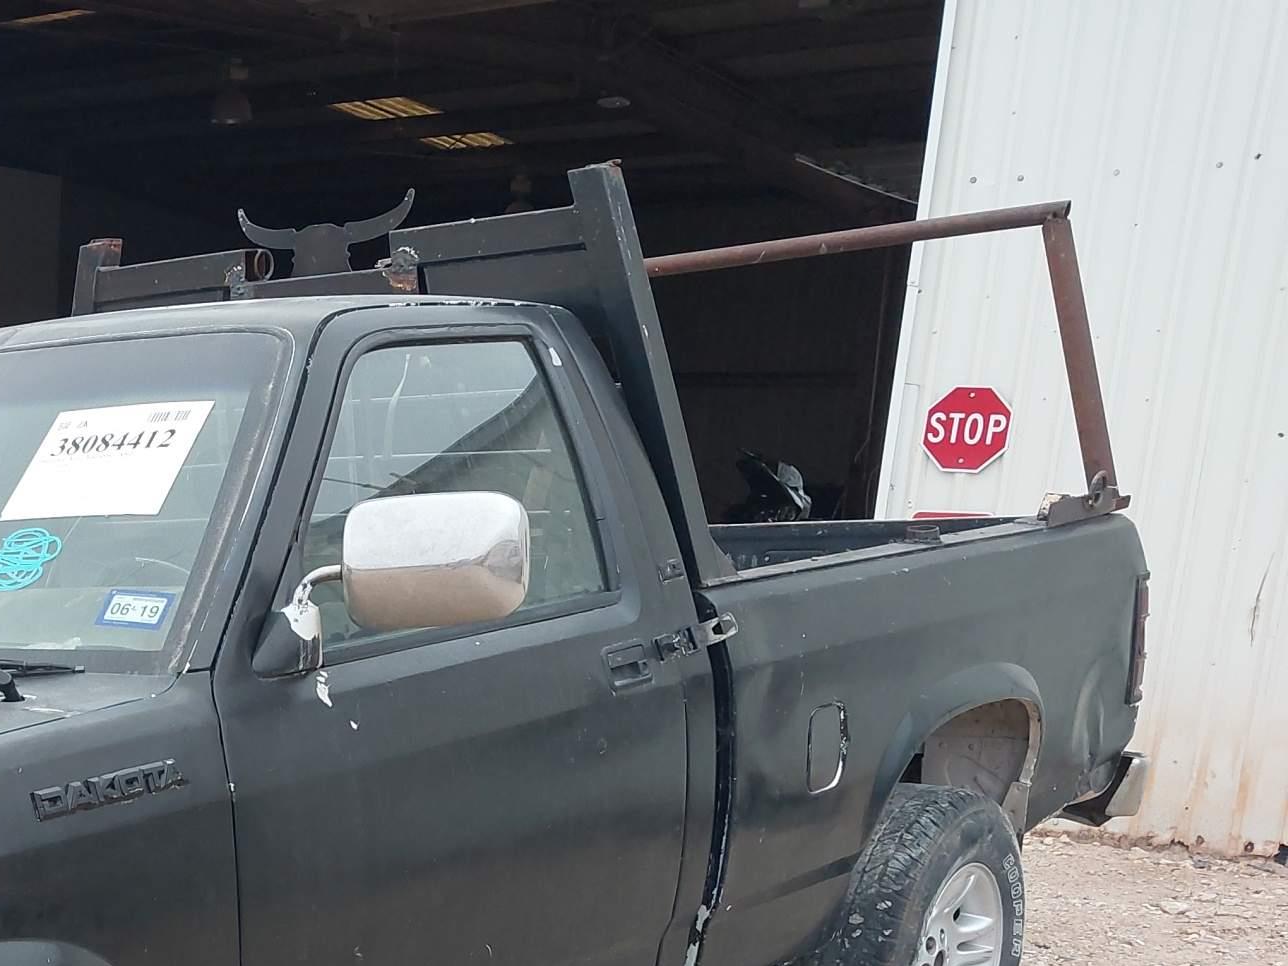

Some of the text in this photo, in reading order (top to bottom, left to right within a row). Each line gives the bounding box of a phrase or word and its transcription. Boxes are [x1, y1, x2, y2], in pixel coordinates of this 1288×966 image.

[50, 428, 176, 457] 38084412
[927, 411, 1007, 445] STOP
[30, 758, 187, 822] DAKOTA
[1002, 852, 1023, 958] COOPER
